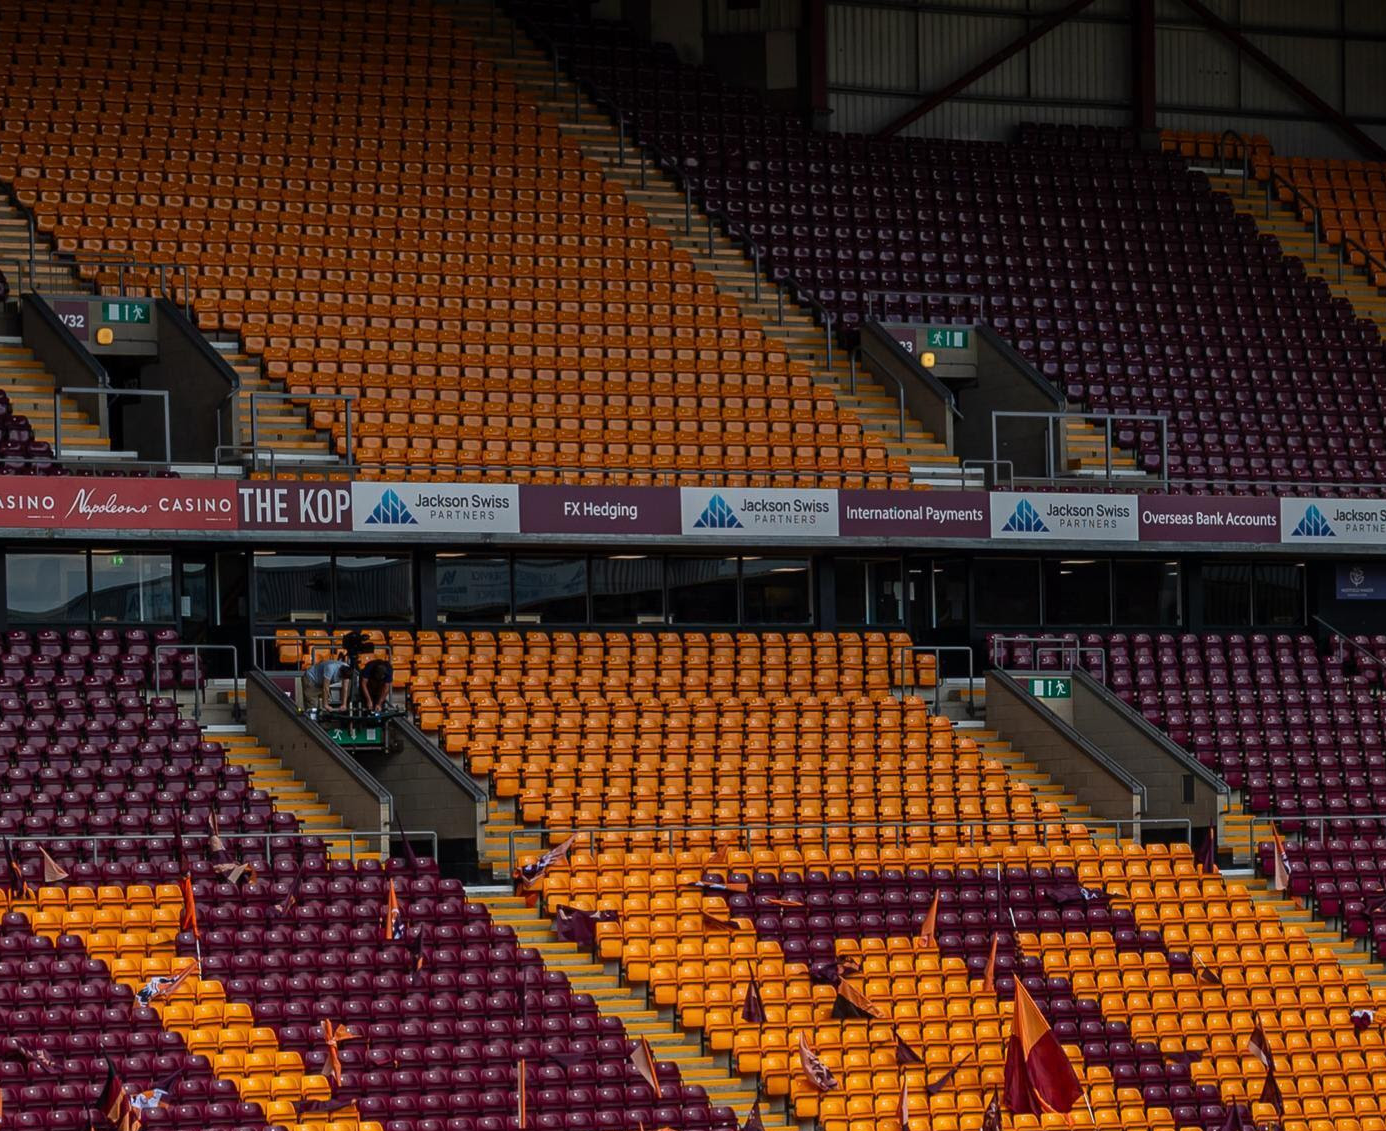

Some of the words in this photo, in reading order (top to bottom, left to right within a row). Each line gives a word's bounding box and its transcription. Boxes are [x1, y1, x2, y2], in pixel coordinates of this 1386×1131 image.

[64, 487, 152, 519] Napoleons
[158, 498, 231, 513] CASINO
[238, 488, 288, 523] THE
[299, 489, 351, 524] KOP
[415, 492, 468, 510] Jackson
[472, 494, 510, 509] Swiss
[740, 499, 791, 515] Jackson
[793, 500, 829, 514] Swiss
[430, 510, 495, 521] PARTNERS
[564, 502, 581, 516] FX
[583, 501, 638, 521] Hedging
[846, 506, 922, 522] International
[925, 506, 983, 524] Payments
[1047, 503, 1093, 518] Jackson
[1096, 504, 1129, 518] Swiss
[1333, 508, 1377, 524] Jackson
[754, 514, 816, 525] PARTNERS
[1059, 518, 1117, 529] PARTNERS
[1143, 511, 1194, 526] Overseas
[1196, 511, 1224, 526] Bank
[1225, 511, 1277, 527] Accounts
